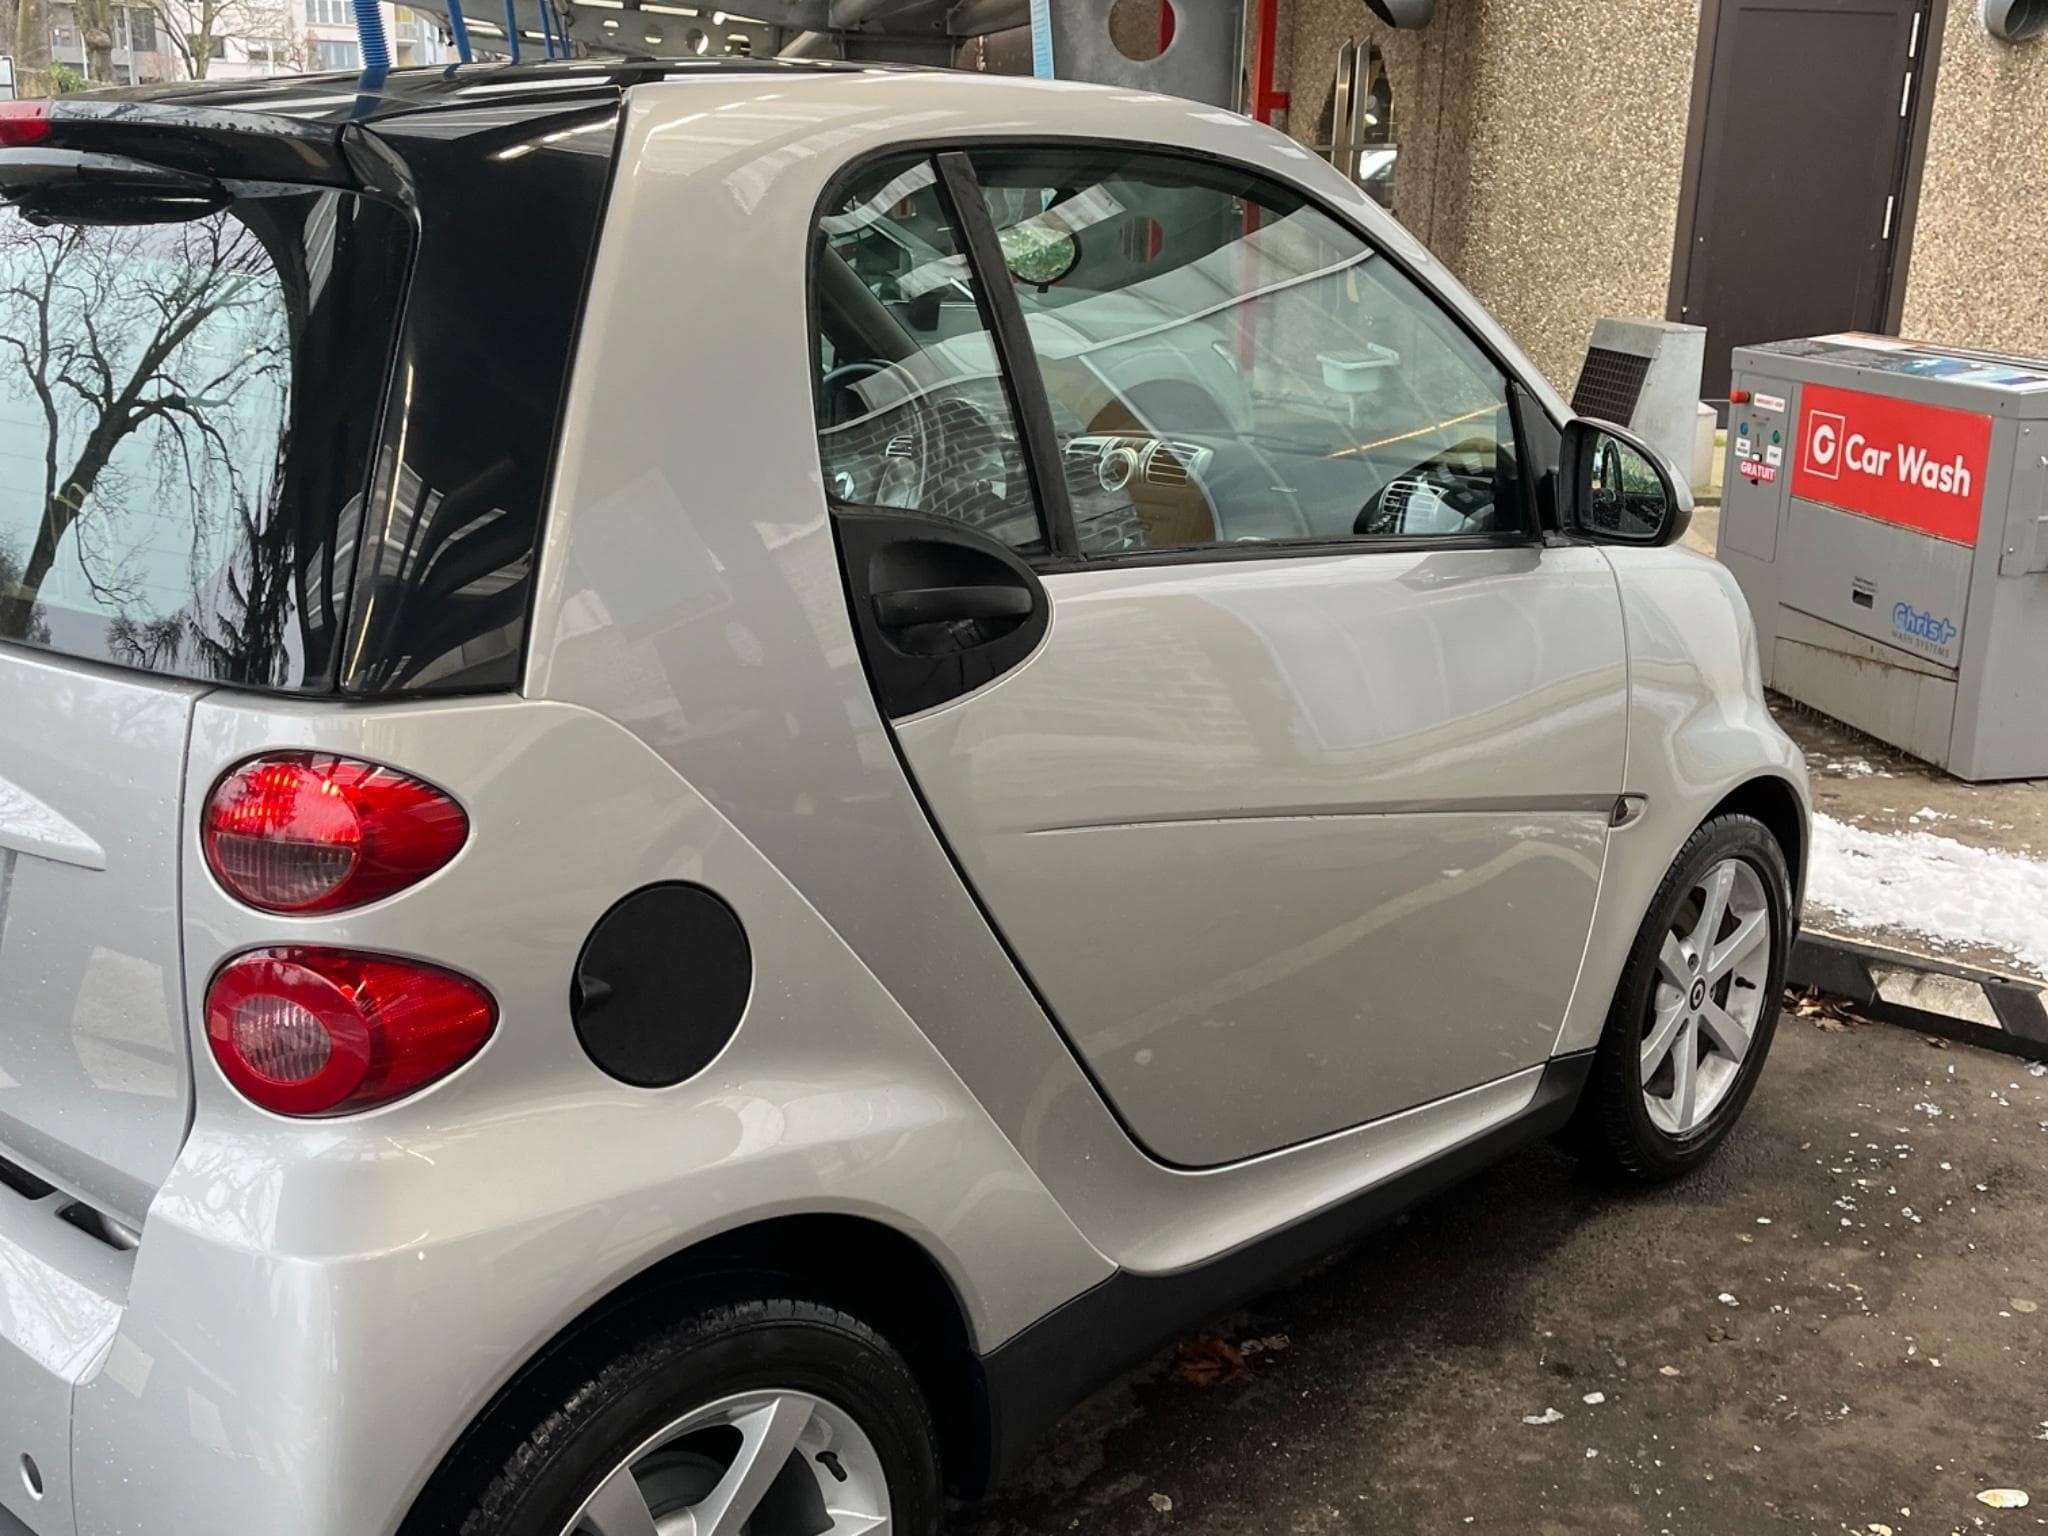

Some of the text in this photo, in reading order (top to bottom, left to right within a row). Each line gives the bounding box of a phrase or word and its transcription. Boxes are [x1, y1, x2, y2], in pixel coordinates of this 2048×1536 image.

[1740, 460, 1775, 481] GRATUIT
[1845, 433, 1892, 476] Car
[1897, 443, 1971, 497] Wash
[1893, 602, 1956, 644] Christ
